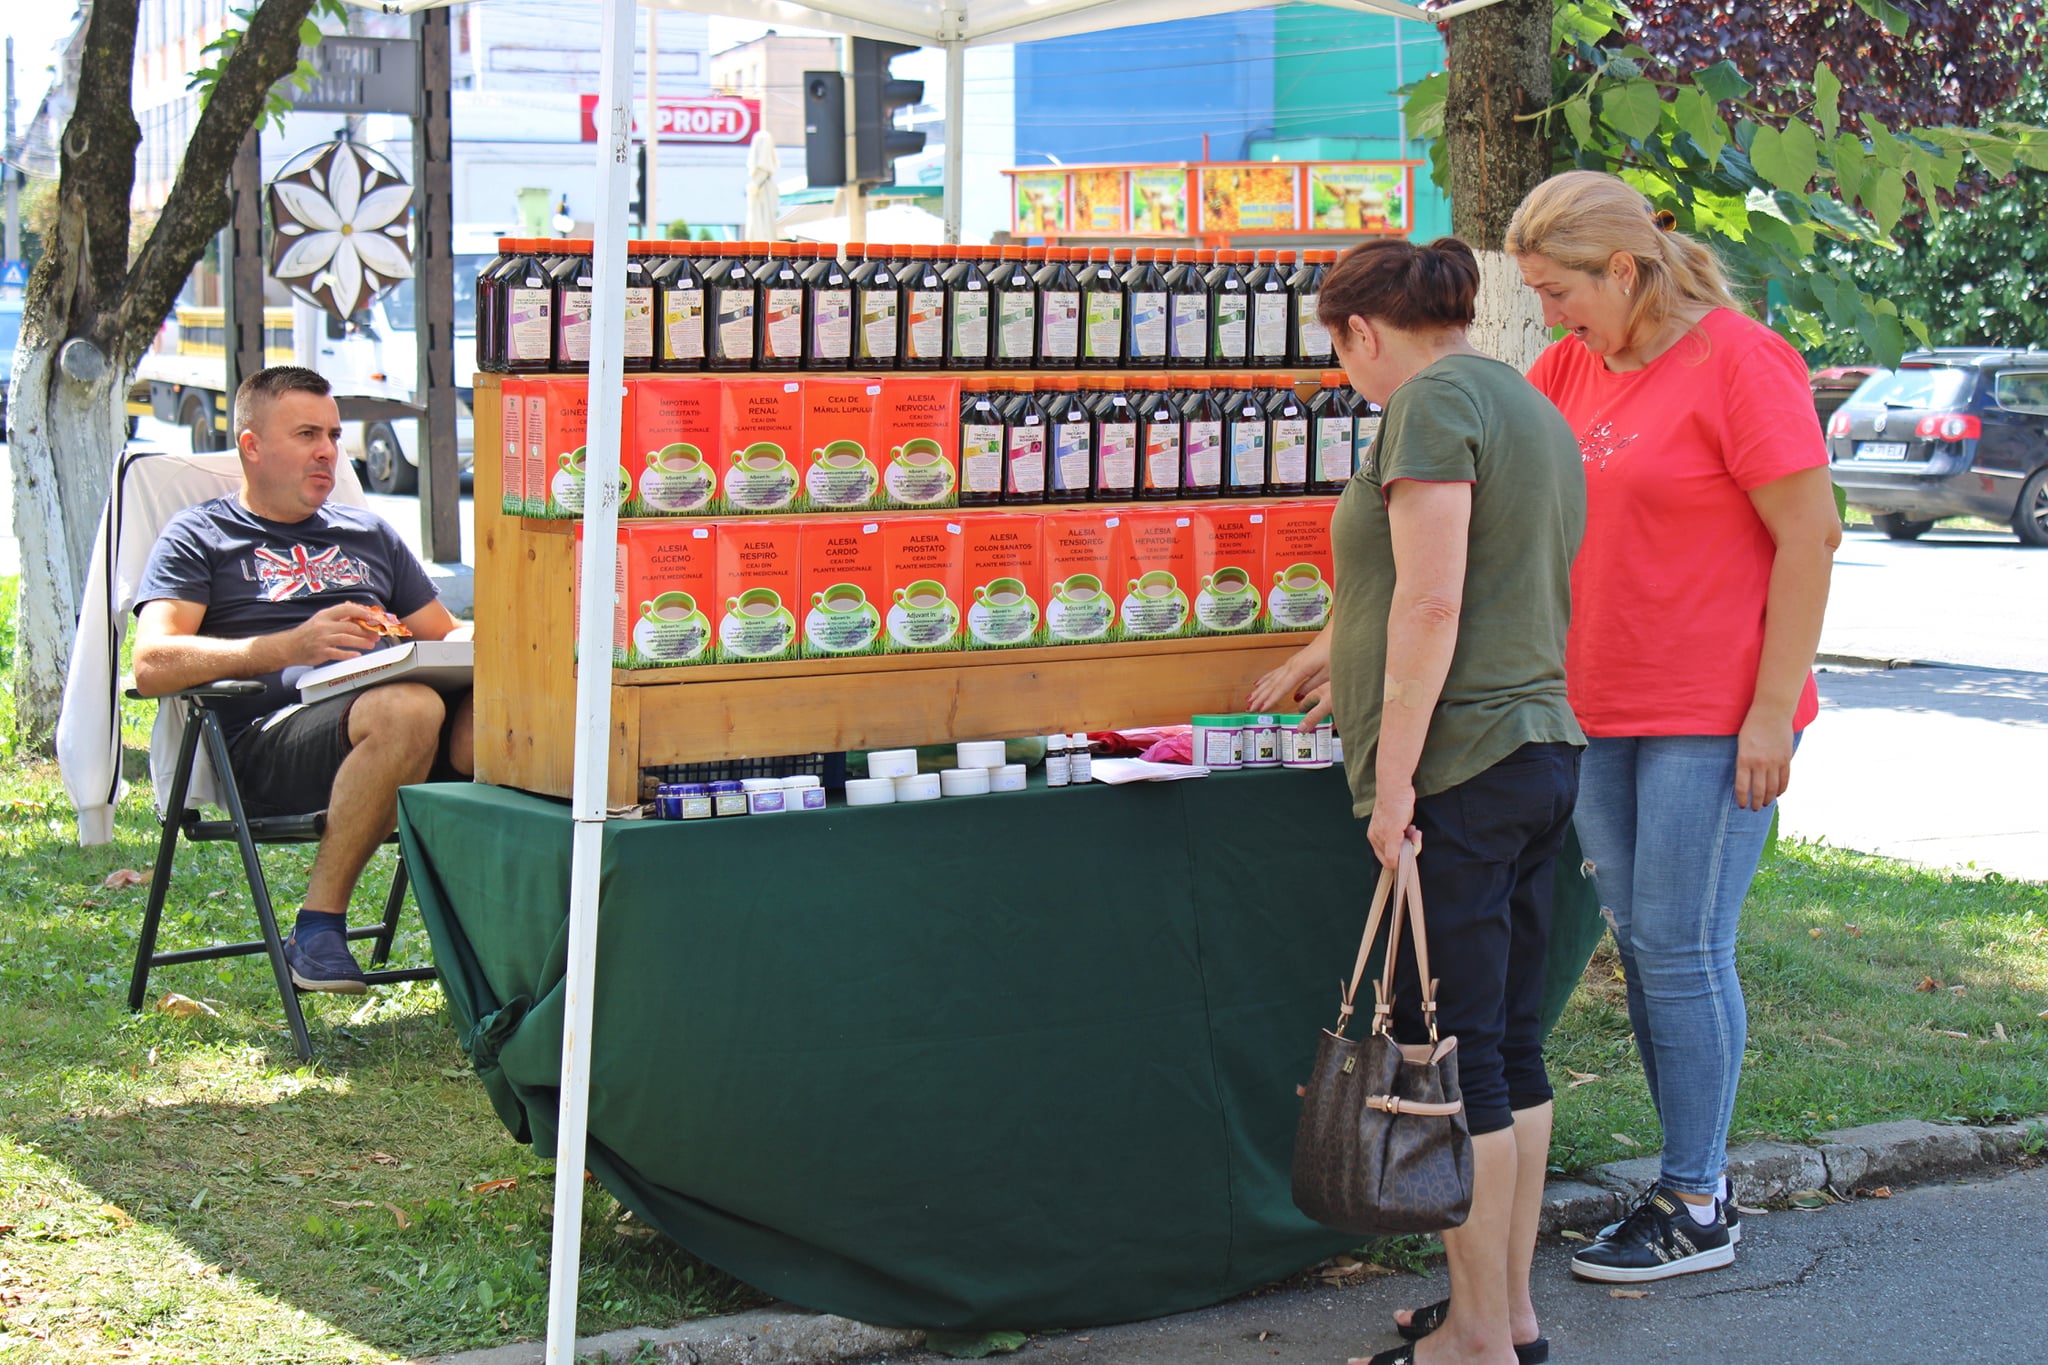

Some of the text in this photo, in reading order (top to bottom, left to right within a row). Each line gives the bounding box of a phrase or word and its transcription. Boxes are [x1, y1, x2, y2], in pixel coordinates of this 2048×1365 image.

[657, 109, 735, 133] PROFI
[749, 397, 779, 405] ALESIA
[906, 394, 936, 402] ALESIA
[1068, 529, 1096, 537] ALESIA
[1144, 527, 1171, 535] ALESIA
[1277, 527, 1326, 535] DERMATOLOGICE
[910, 535, 939, 543] ALESIA
[989, 533, 1018, 541] ALESIA
[743, 542, 775, 550] ALESIA
[827, 538, 858, 546] ALESIA
[657, 544, 689, 553] ALESIA
